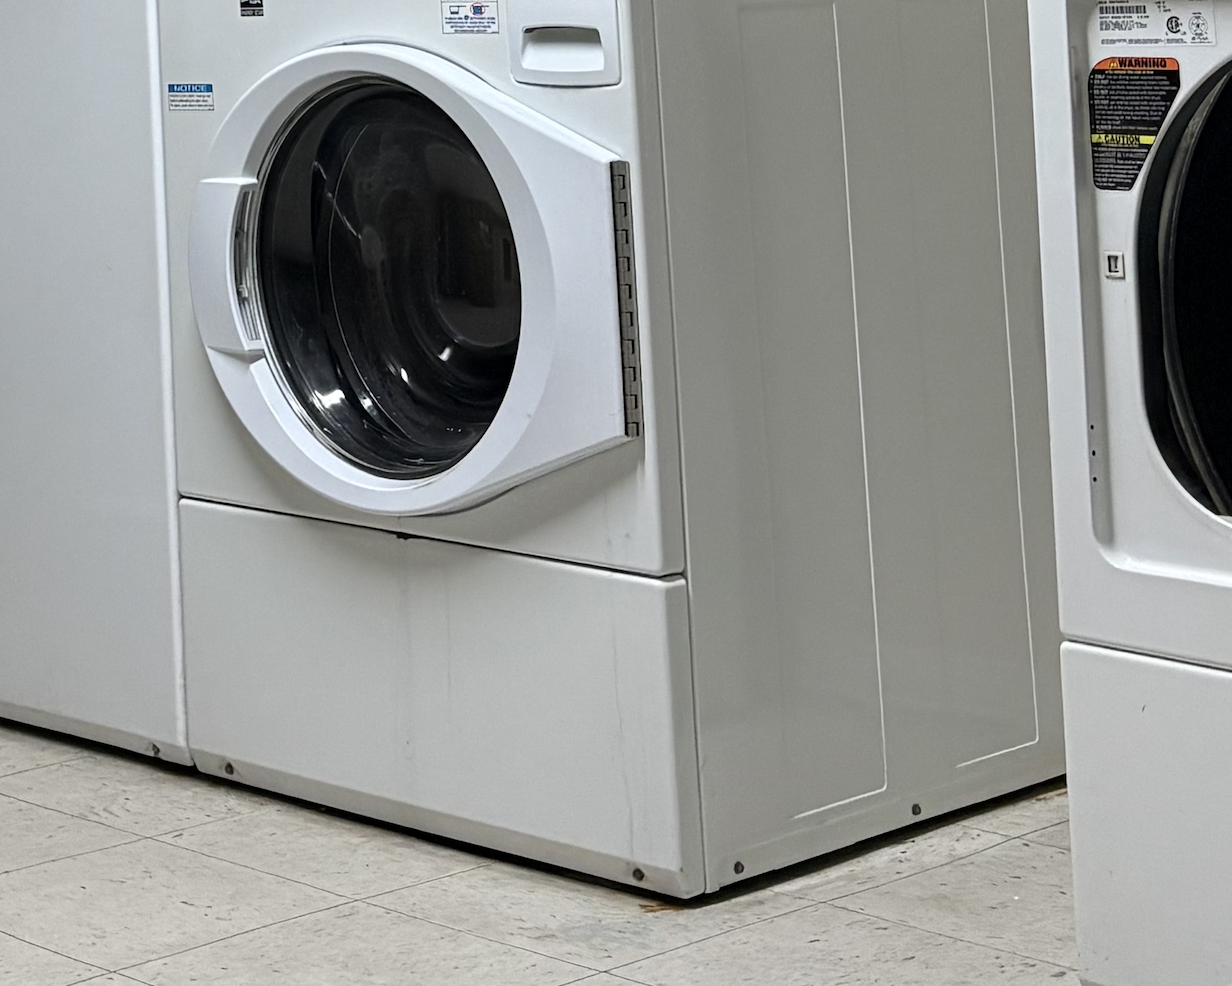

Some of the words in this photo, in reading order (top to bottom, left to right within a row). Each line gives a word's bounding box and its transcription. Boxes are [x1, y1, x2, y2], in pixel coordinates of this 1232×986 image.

[1117, 57, 1167, 68] WARNING
[173, 84, 208, 92] NOTICE
[1104, 134, 1140, 145] CAUTION
